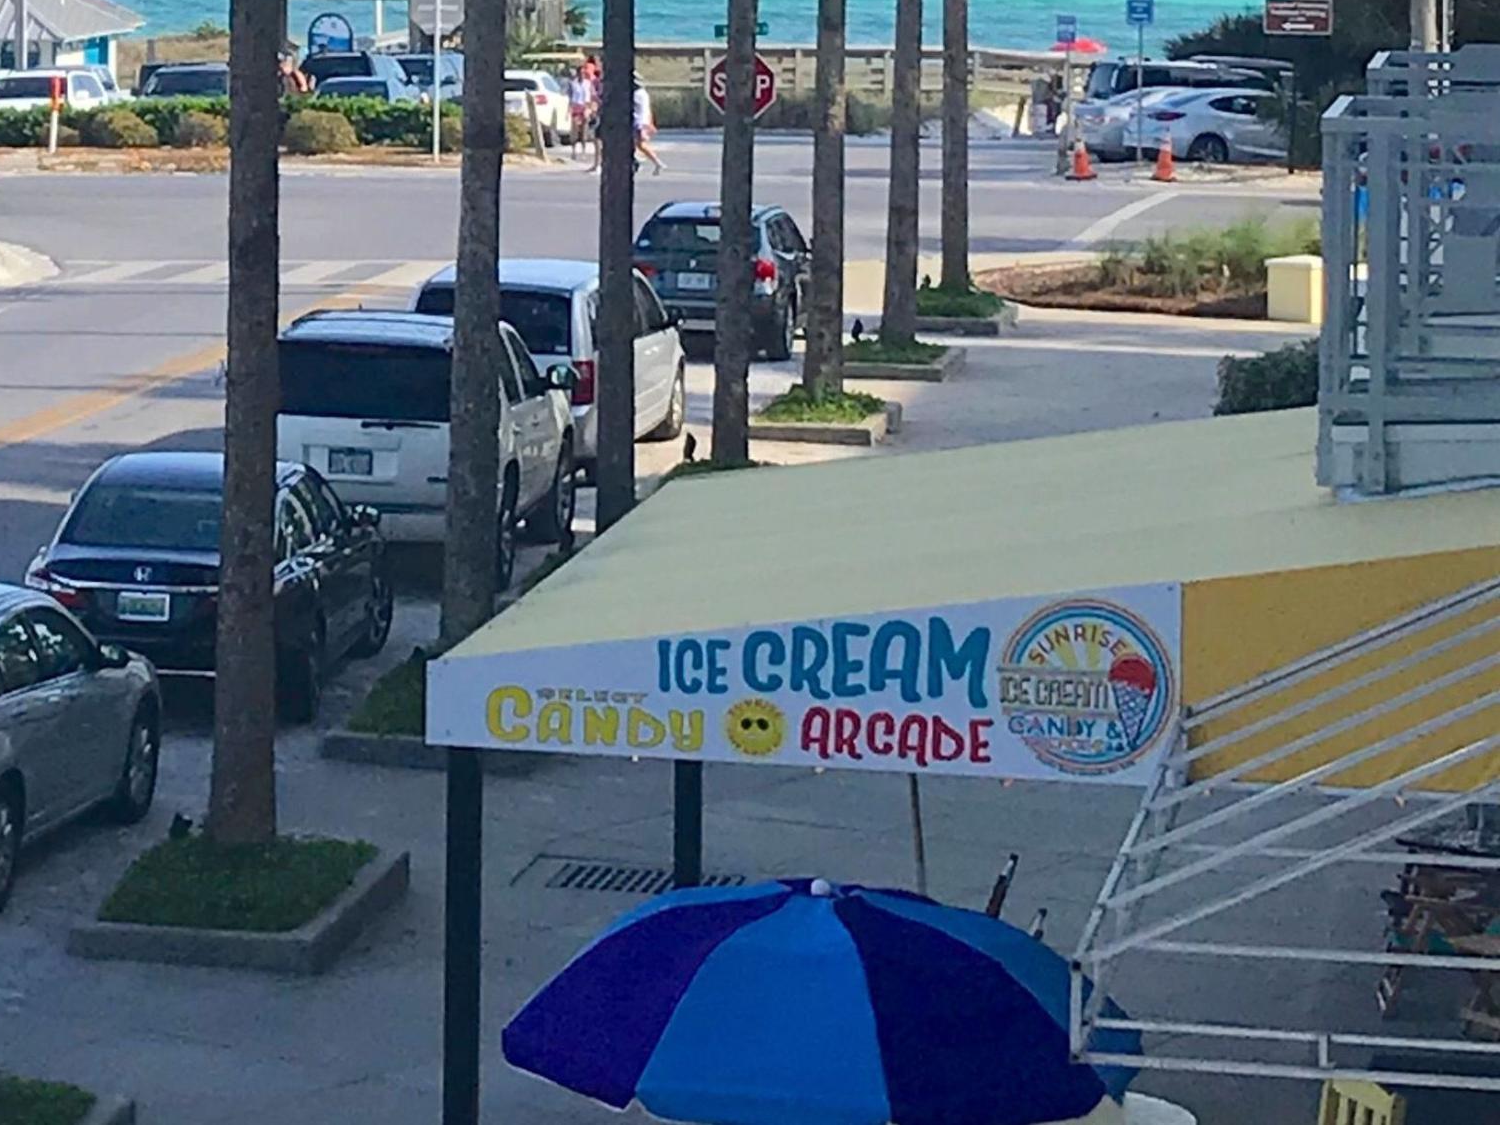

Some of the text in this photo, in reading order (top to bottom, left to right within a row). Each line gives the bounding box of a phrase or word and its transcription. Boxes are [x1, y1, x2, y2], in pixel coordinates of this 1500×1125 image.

[712, 71, 771, 100] SP
[657, 616, 992, 709] ICE CREAM
[1028, 623, 1128, 666] SUNRISE
[1036, 678, 1110, 710] CREAM
[485, 684, 705, 753] CANDY
[801, 705, 995, 768] ARCADE
[1008, 714, 1098, 739] CANDY
